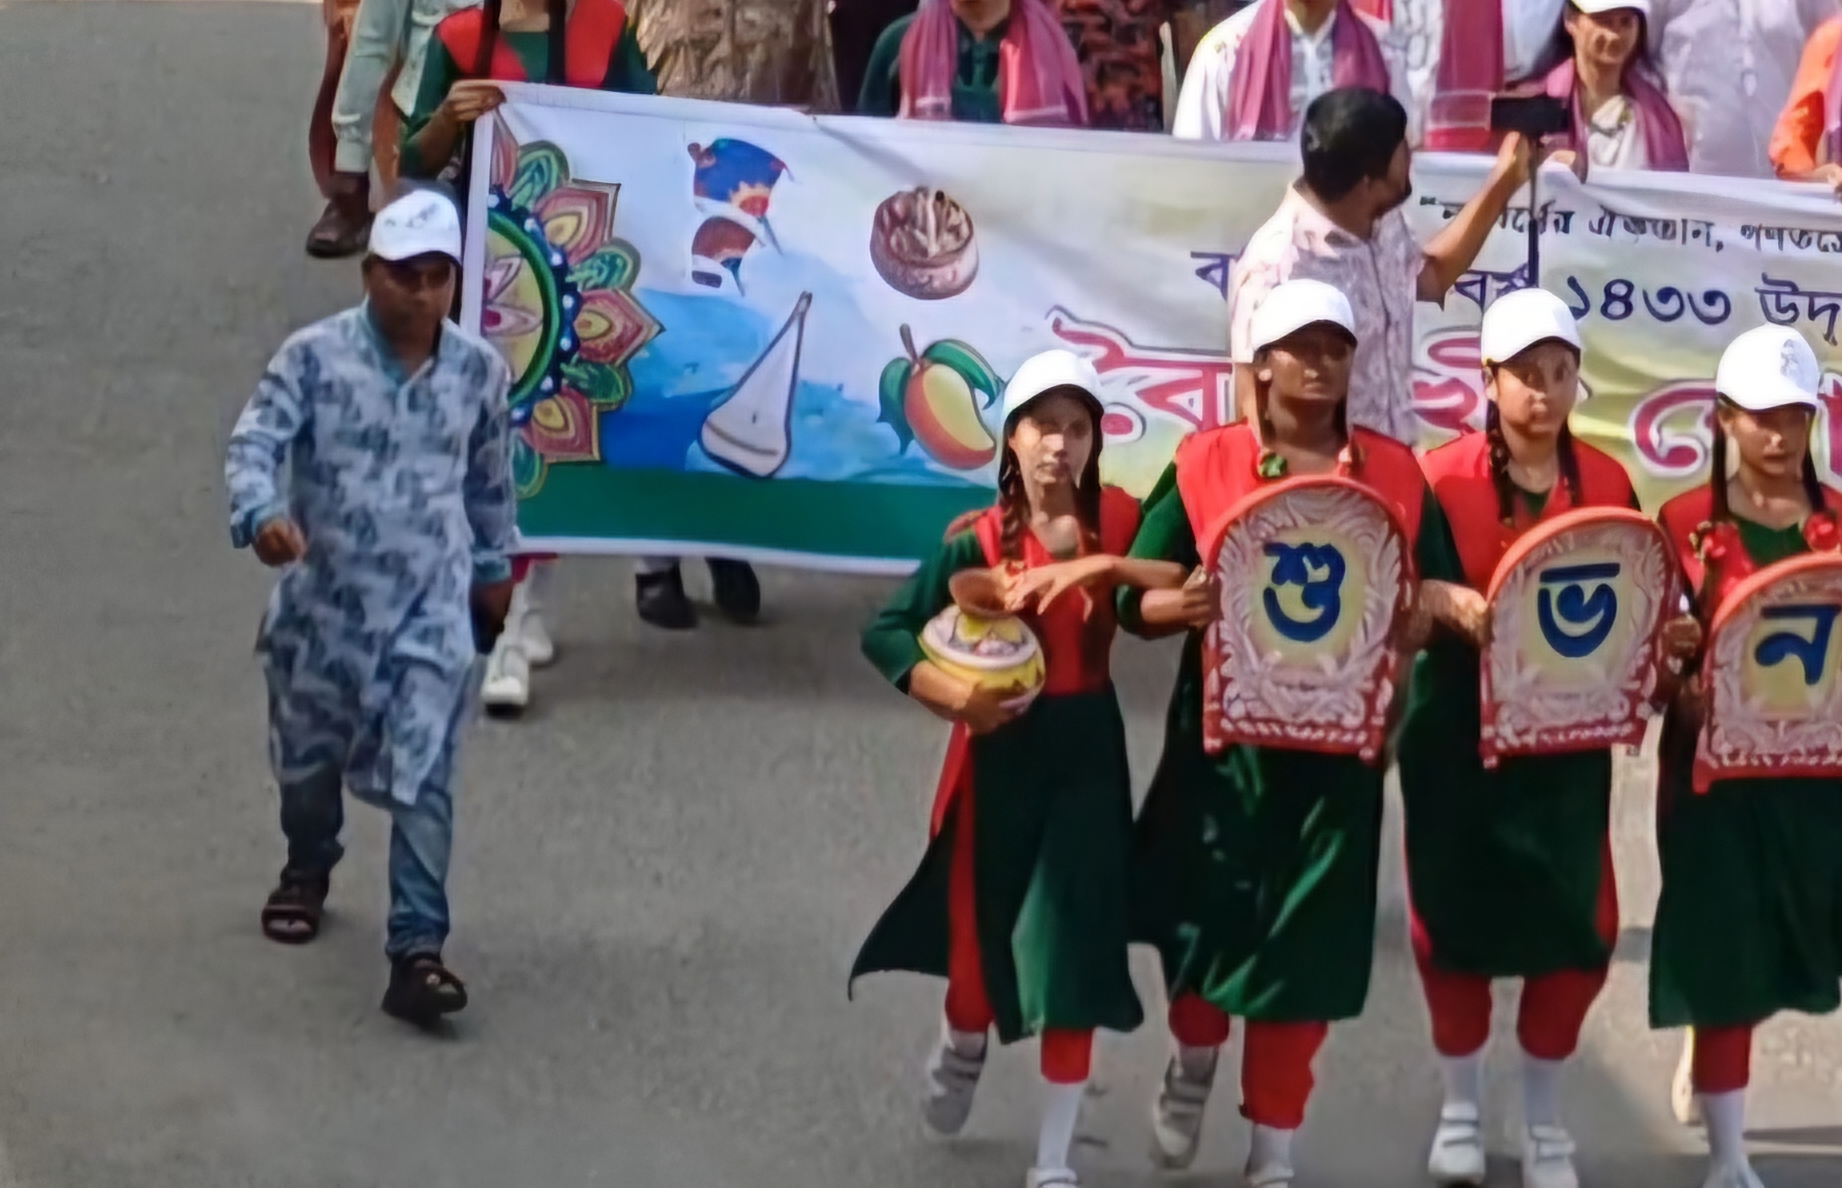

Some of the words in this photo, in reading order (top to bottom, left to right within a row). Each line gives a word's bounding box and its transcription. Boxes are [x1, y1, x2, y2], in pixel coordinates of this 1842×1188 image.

[1566, 275, 1731, 325] ১৪৩৩
[1262, 542, 1346, 642] শু
[1537, 562, 1621, 658] ভ
[1754, 603, 1842, 685] ন
